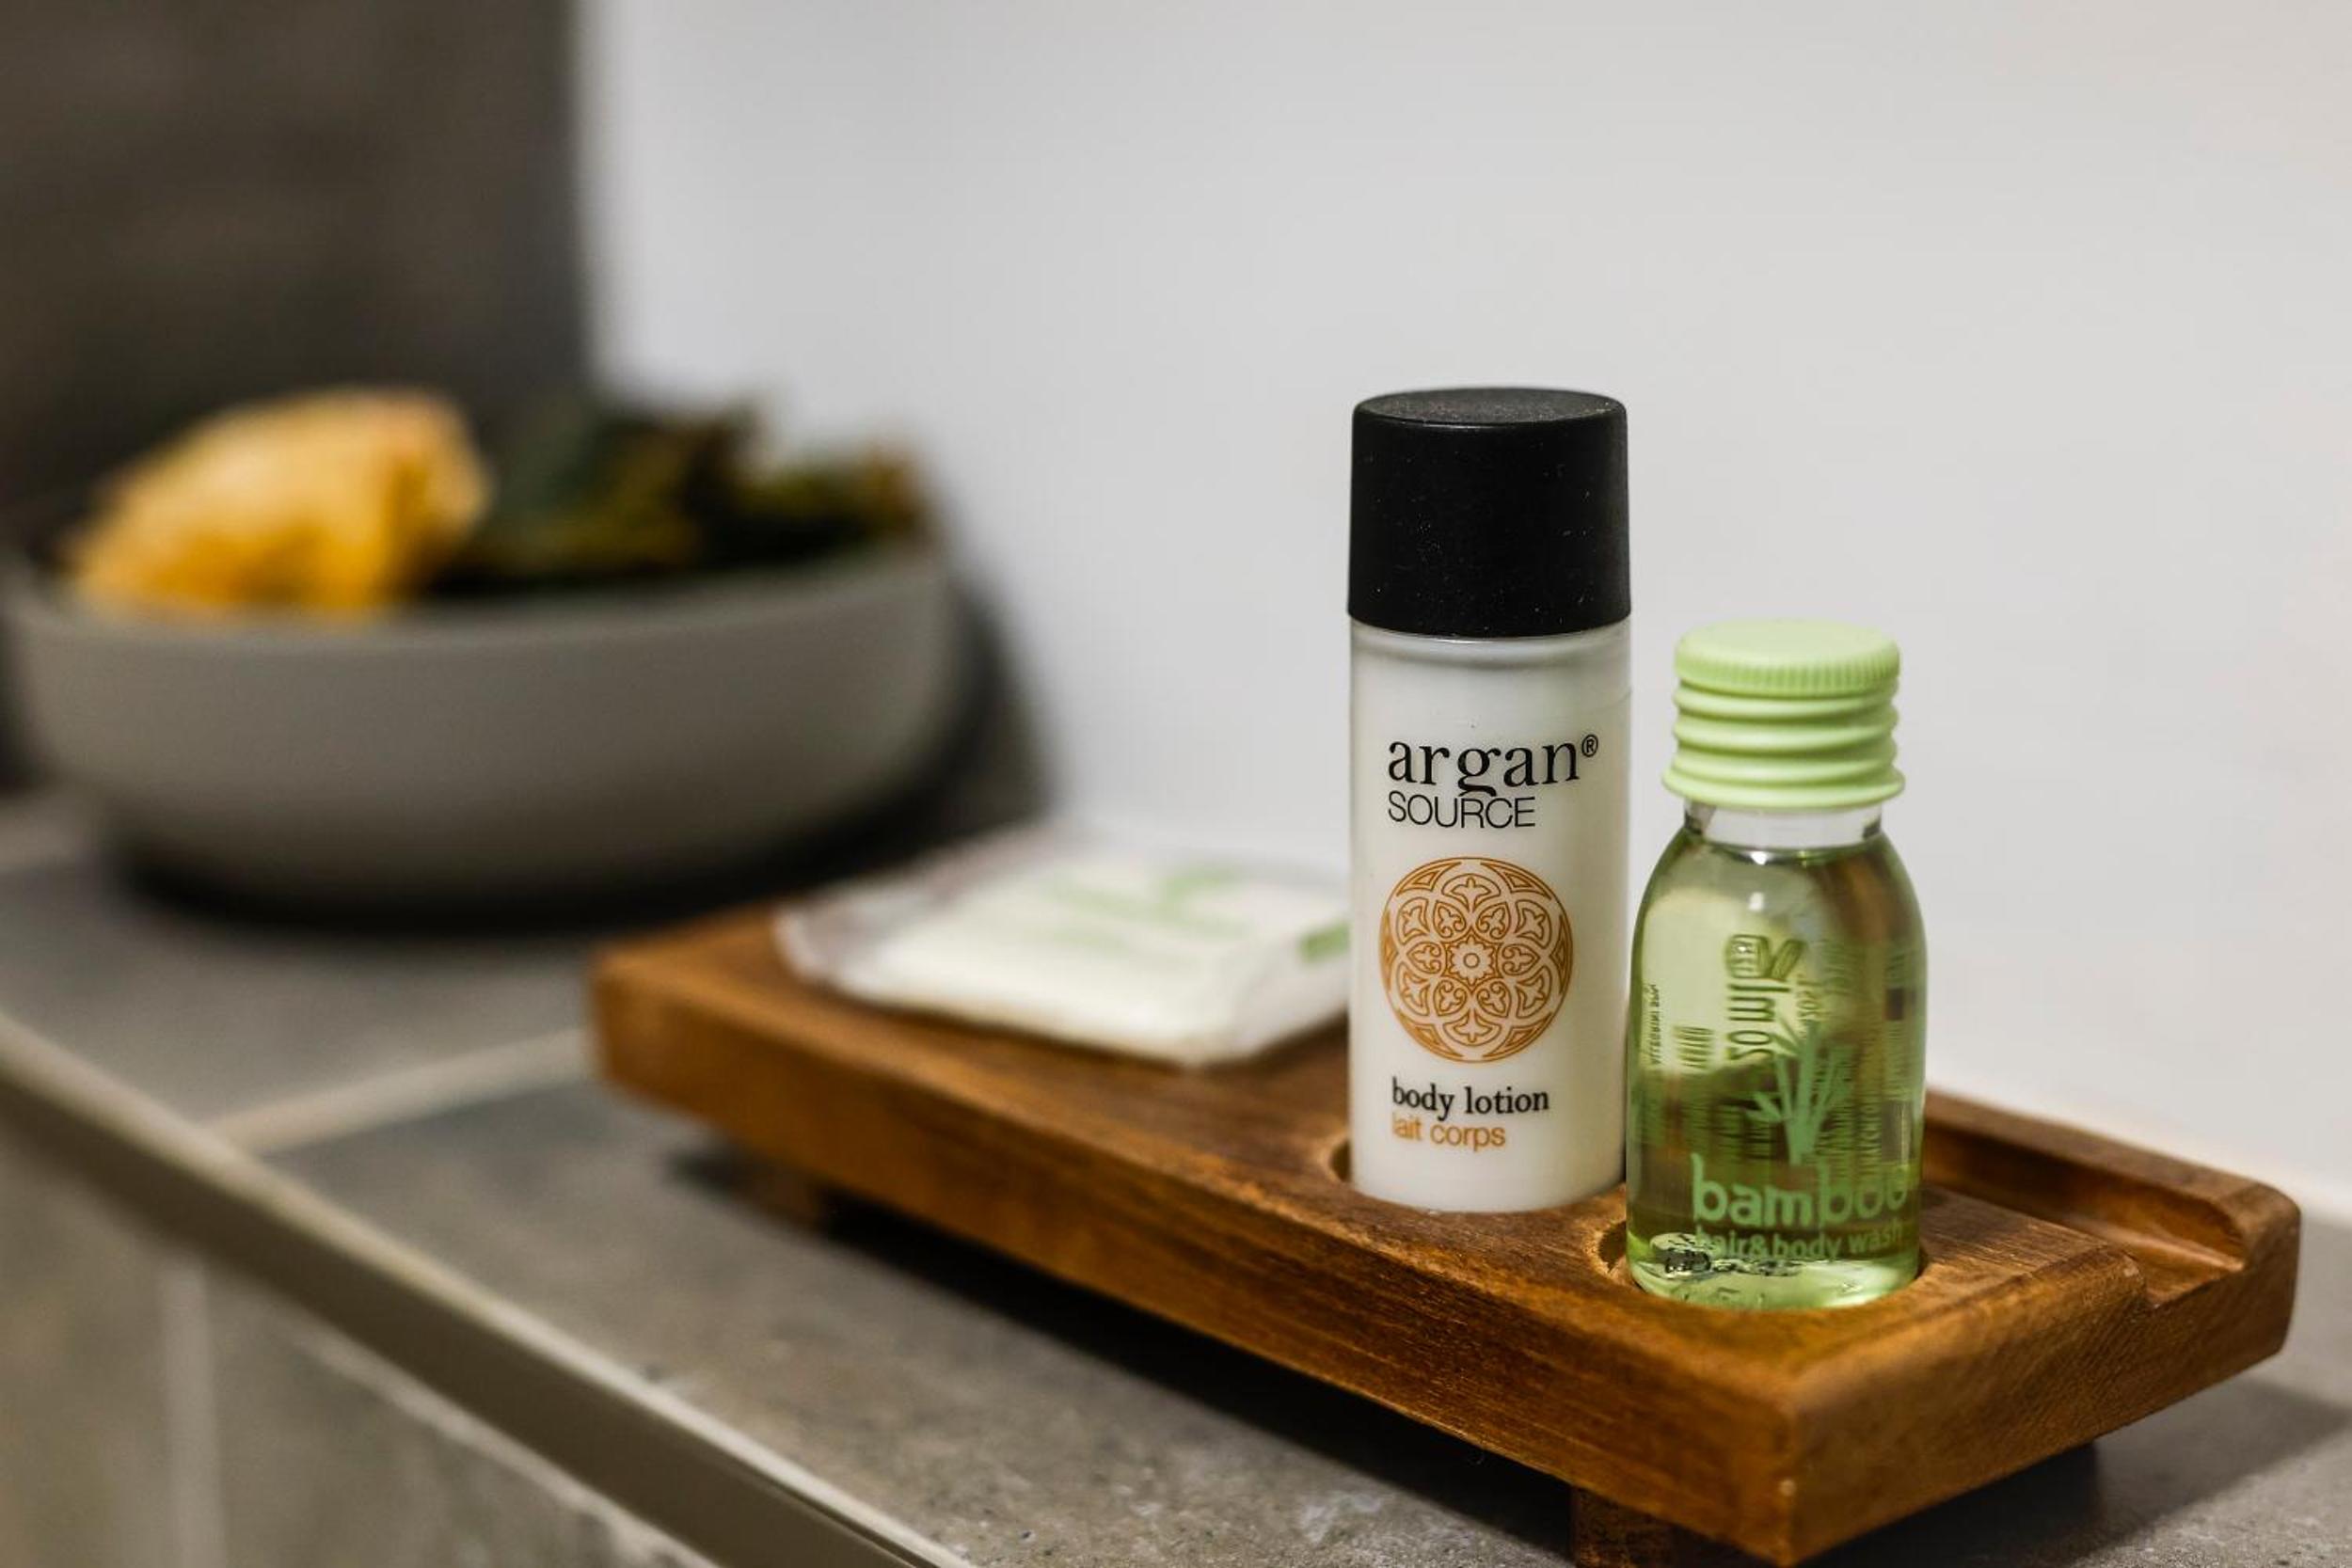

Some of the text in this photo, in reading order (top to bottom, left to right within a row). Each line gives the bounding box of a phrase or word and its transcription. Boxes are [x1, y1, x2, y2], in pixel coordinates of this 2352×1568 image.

[1388, 790, 1535, 828] SOURCE
[1392, 1076, 1549, 1121] body lotion
[1392, 1112, 1506, 1152] lait corps
[1691, 1153, 1910, 1228] bamboo
[1847, 1218, 1903, 1255] wash
